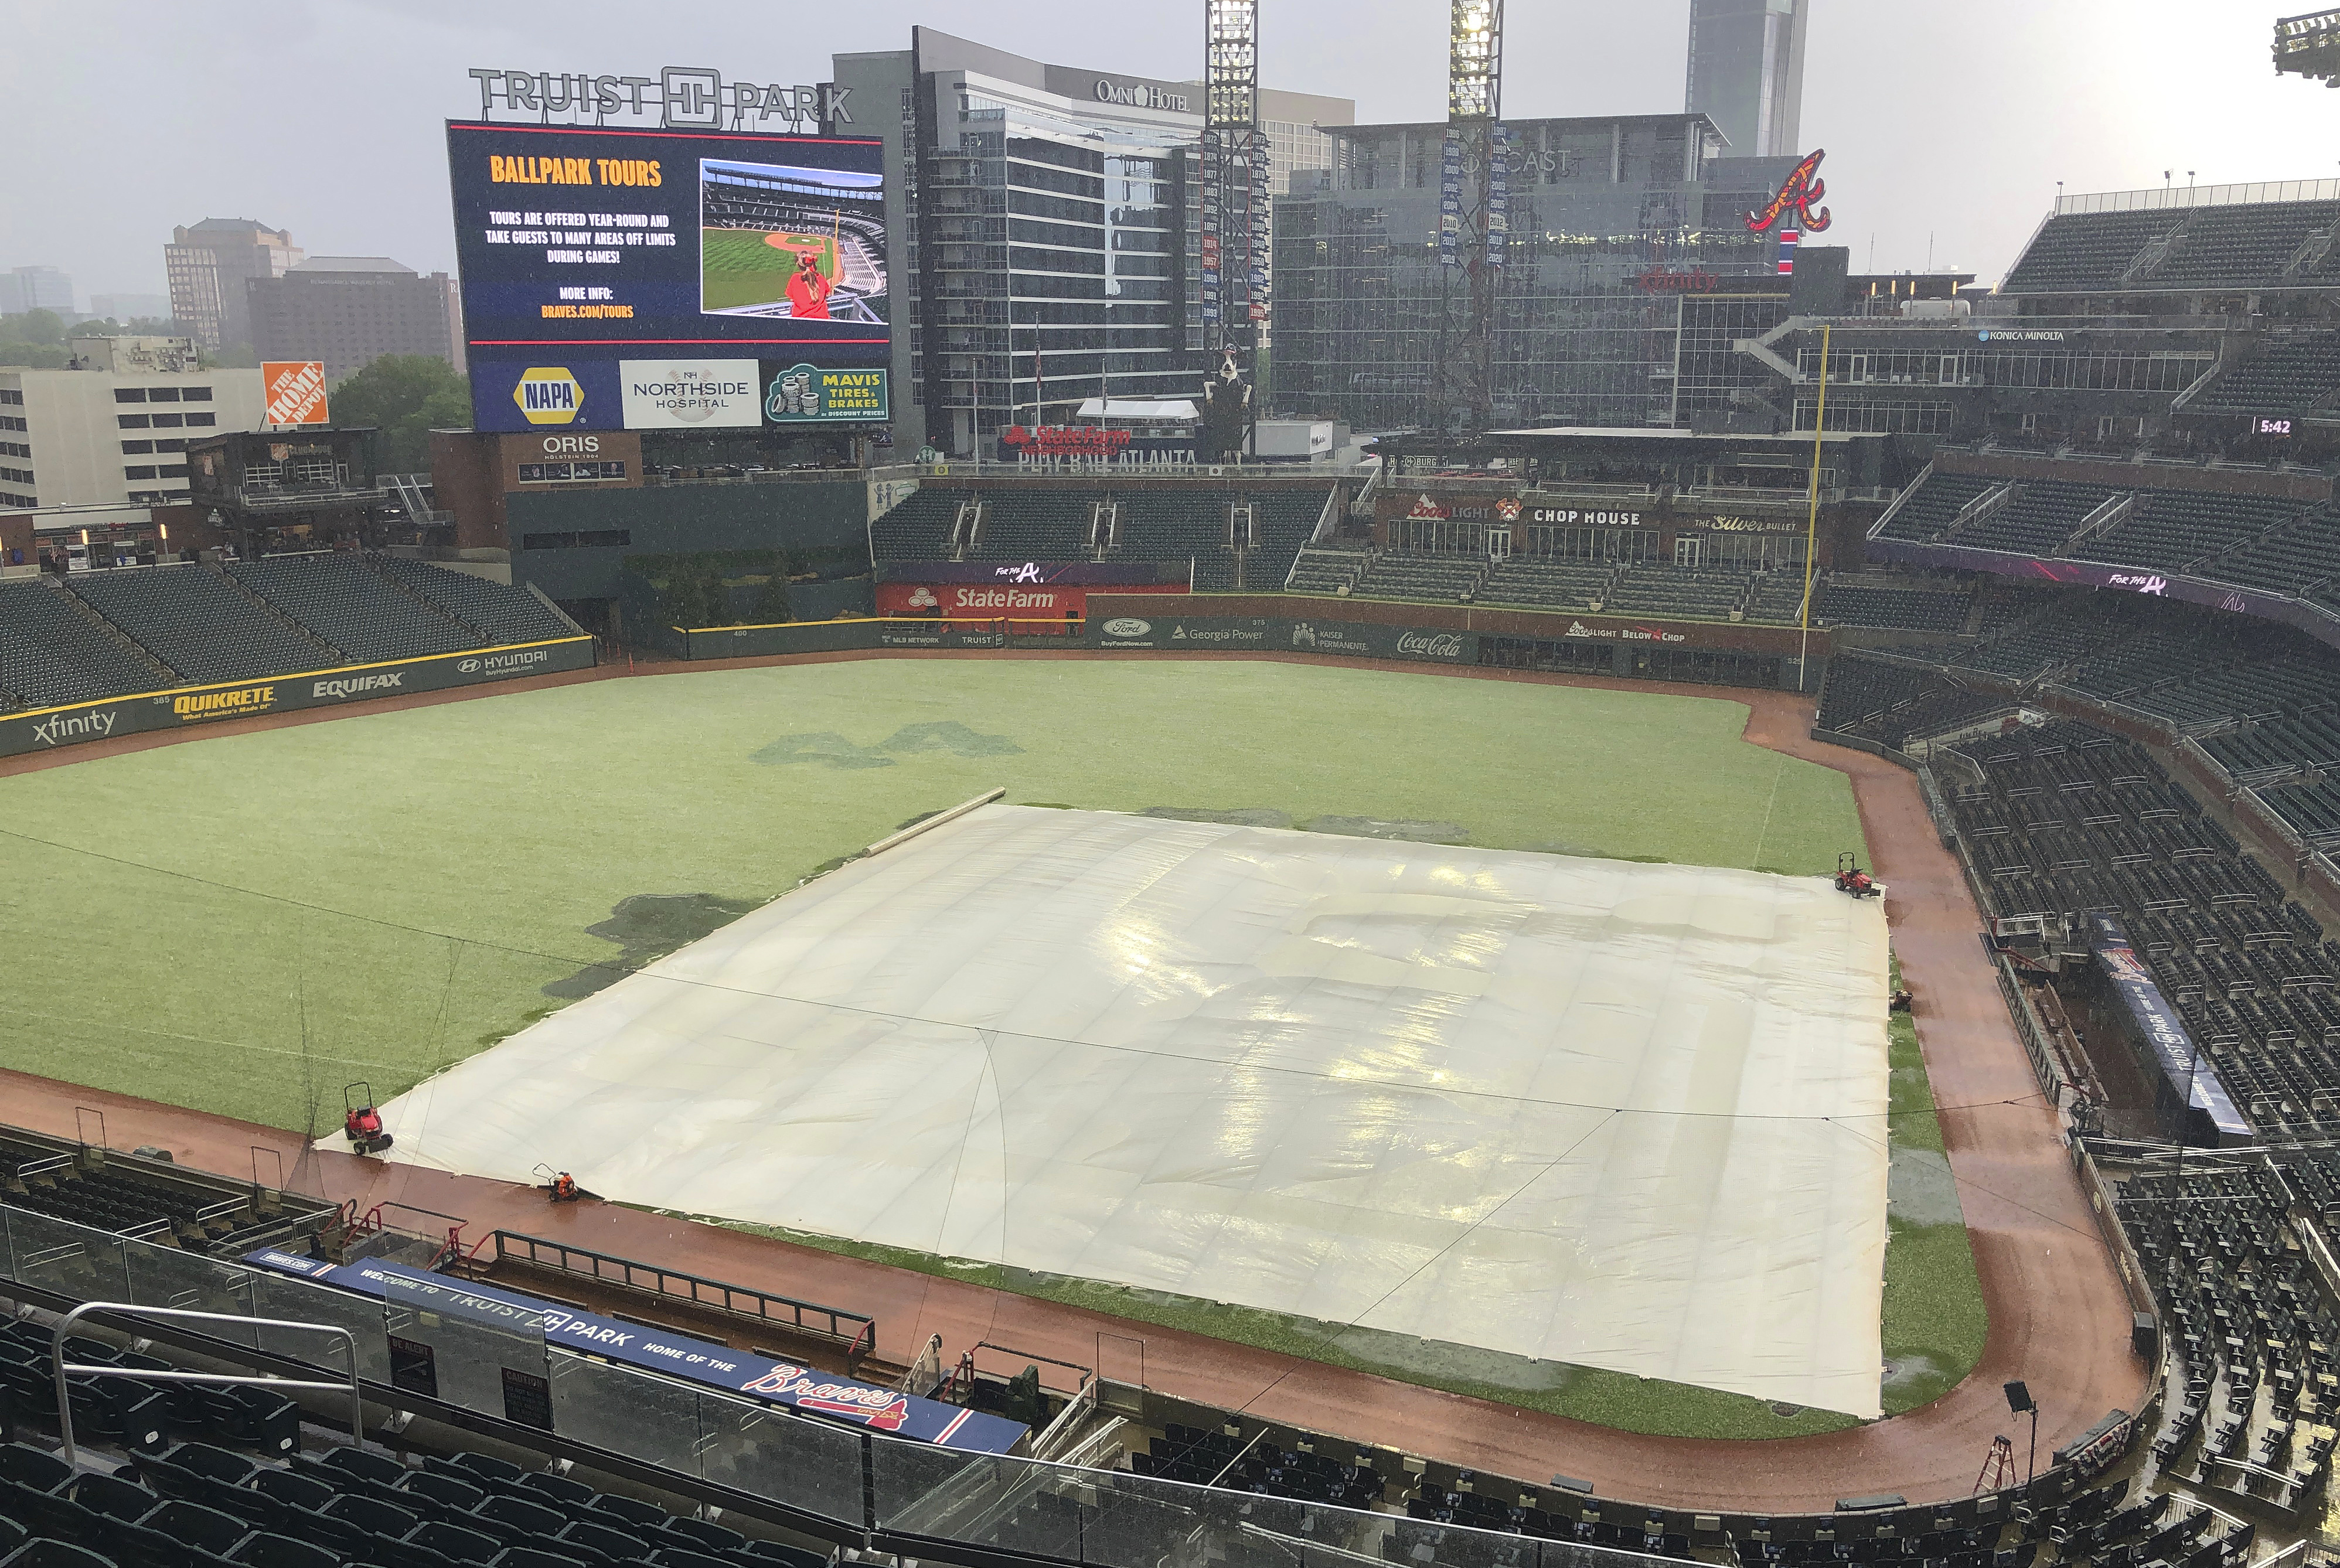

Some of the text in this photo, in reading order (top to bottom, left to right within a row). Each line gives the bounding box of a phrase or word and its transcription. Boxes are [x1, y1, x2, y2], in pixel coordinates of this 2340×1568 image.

[469, 68, 854, 124] TRUIST PARK
[1446, 128, 1460, 139] 1996
[1493, 127, 1507, 137] 1997
[1204, 134, 1217, 144] 1872
[1445, 147, 1459, 156] 1998
[1493, 145, 1506, 154] 1999
[1204, 152, 1217, 161] 1874
[1252, 152, 1265, 162] 1875
[490, 155, 662, 187] BALLPARK TOURS
[1445, 165, 1459, 175] 2000
[1492, 163, 1505, 173] 2001
[1204, 169, 1217, 179] 1877
[1444, 182, 1458, 193] 2002
[1491, 181, 1505, 191] 2003
[1204, 187, 1217, 197] 1883
[1252, 187, 1265, 197] 1891
[1443, 200, 1457, 211] 2004
[1490, 199, 1505, 209] 2005
[489, 211, 669, 227] TOURS ARE OFFERED YEAR-ROUND AND
[1443, 219, 1456, 229] 2010
[1490, 217, 1503, 227] 2012
[1204, 221, 1217, 231] 1897
[1251, 222, 1266, 231] 1898
[485, 230, 676, 246] TAKE GUESTS TO MANY AREAS OFF LIMITS
[1442, 236, 1456, 246] 2013
[1489, 235, 1503, 245] 2018
[1204, 239, 1217, 248] 1914
[1251, 239, 1265, 249] 1948
[547, 250, 621, 264] DURING GAMES!
[1204, 257, 1217, 266] 1957
[1251, 257, 1265, 266] 1958
[1442, 254, 1455, 264] 2019
[1489, 253, 1503, 263] 2020
[1204, 274, 1217, 283] 1969
[1251, 274, 1265, 284] 1982
[560, 287, 613, 300] MORE INFO:
[1204, 291, 1217, 300] 1991
[1251, 291, 1264, 301] 1992
[541, 305, 634, 319] BRAVES.COM/TOURS
[1204, 308, 1217, 317] 1993
[1251, 308, 1264, 318] 1995
[1990, 332, 2063, 341] KONICA MINOLTA
[271, 369, 295, 393] THE
[822, 374, 880, 386] MAVIS
[268, 362, 324, 423] HOME
[633, 382, 748, 396] NORTHSIDE
[830, 388, 868, 398] TIRES
[525, 383, 574, 410] NAPA
[292, 384, 326, 423] DEPOT
[656, 399, 729, 408] HOSPITAL
[828, 399, 878, 408] BRAKES
[2260, 420, 2291, 433] 5:42
[543, 436, 600, 453] ORIS
[1021, 445, 1118, 455] NEIGHBORHOOD
[1118, 449, 1197, 472] ATLANTA
[1409, 502, 1452, 517] Coors
[1452, 507, 1489, 519] LIGHT
[1534, 509, 1578, 523] CHOP
[1585, 512, 1640, 526] HOUSE
[1695, 514, 1796, 531] THE Silver BULLET
[1113, 621, 1140, 633] Ford
[1190, 630, 1263, 641] Georgia Power
[1320, 631, 1343, 639] KAISER
[1622, 630, 1651, 640] BELOW
[1662, 633, 1685, 642] CHOP
[1320, 640, 1367, 651] PERMANENTE
[485, 650, 547, 669] HYUNDAI
[485, 665, 534, 676] BuyHyundai.com
[313, 673, 403, 698] EQUIFAX
[153, 696, 170, 705] 385
[174, 686, 274, 713] QUIKRETE
[203, 708, 237, 718] America's
[32, 710, 117, 745] xfinity
[2147, 1014, 2172, 1033] PARK
[2164, 1044, 2193, 1071] TRUIST
[265, 1255, 311, 1269] BRAVES.COM
[360, 1269, 421, 1290] WELCOME
[449, 1293, 635, 1347] TRUIST PARK
[642, 1342, 899, 1407] HOME OF THE Braves
[507, 1371, 543, 1389] CAUTION
